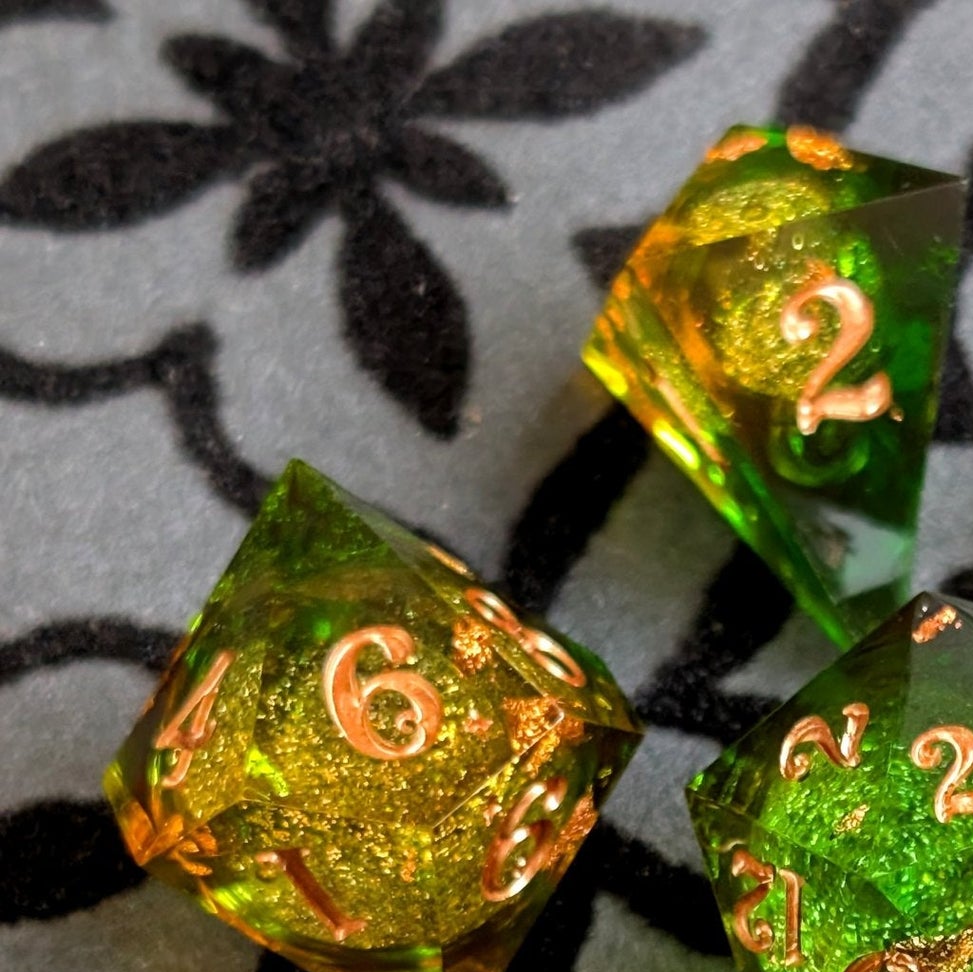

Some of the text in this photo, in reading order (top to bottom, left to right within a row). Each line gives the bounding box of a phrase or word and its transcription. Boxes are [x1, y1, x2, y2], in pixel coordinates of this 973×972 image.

[780, 278, 892, 436] 2
[153, 650, 236, 788] 4
[324, 625, 444, 761] 6
[779, 702, 870, 782] 2
